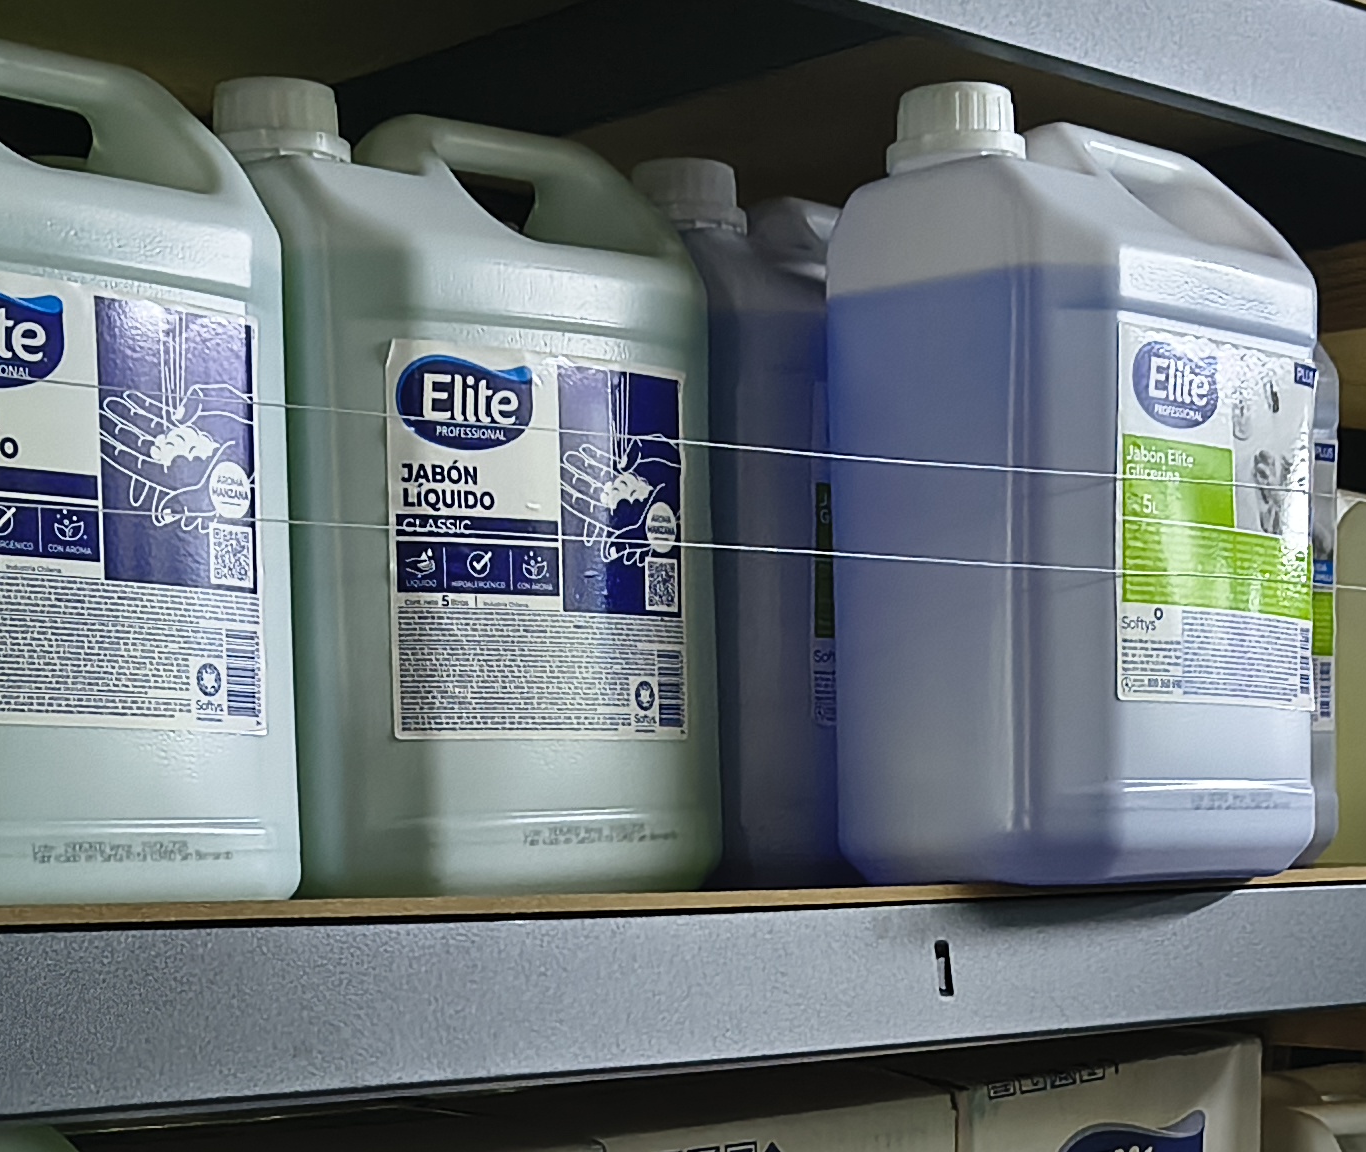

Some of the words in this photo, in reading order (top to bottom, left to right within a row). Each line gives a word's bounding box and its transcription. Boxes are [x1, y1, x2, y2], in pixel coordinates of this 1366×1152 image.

[1148, 356, 1210, 406] Elite
[423, 372, 519, 425] Elite
[436, 424, 506, 441] PROFESSIONAL
[1126, 444, 1165, 464] Jabón
[1168, 449, 1194, 468] Elite
[401, 460, 478, 485] JABÓN
[402, 483, 495, 511] LÍQUIDO
[403, 518, 472, 534] CLASSIC
[441, 594, 450, 607] 5
[1121, 615, 1156, 633] Softys
